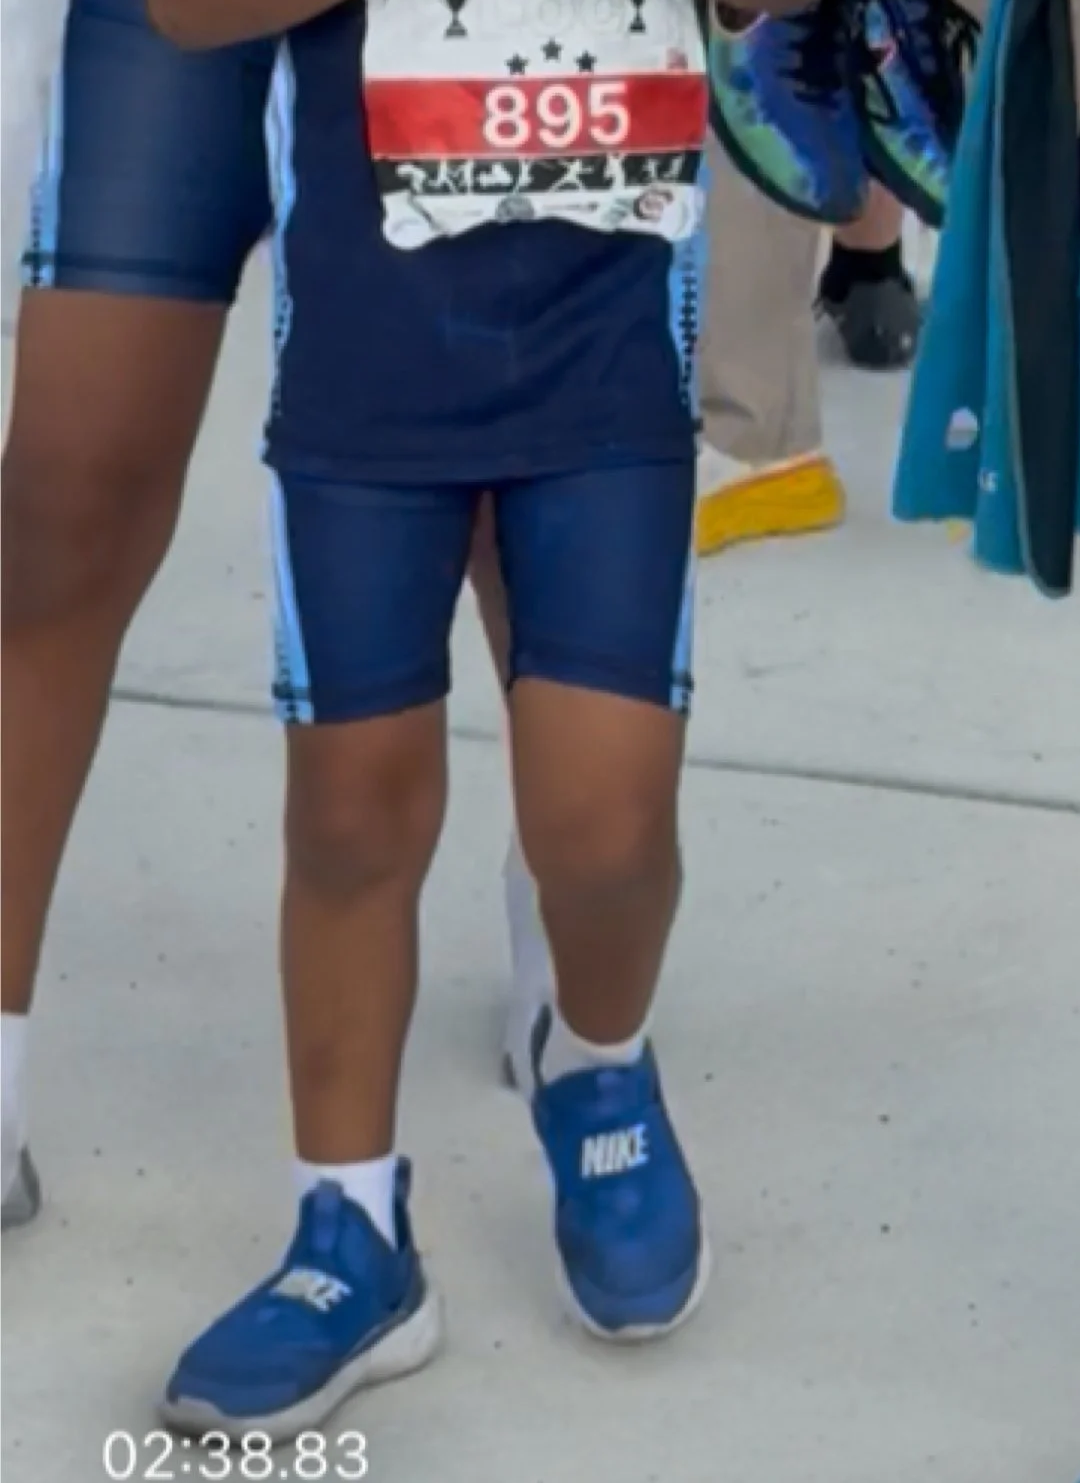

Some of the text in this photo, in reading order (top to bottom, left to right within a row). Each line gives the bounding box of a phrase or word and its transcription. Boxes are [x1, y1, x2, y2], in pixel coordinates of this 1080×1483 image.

[482, 83, 631, 148] 895
[580, 1124, 649, 1178] NIKE
[271, 1267, 353, 1311] NIKE
